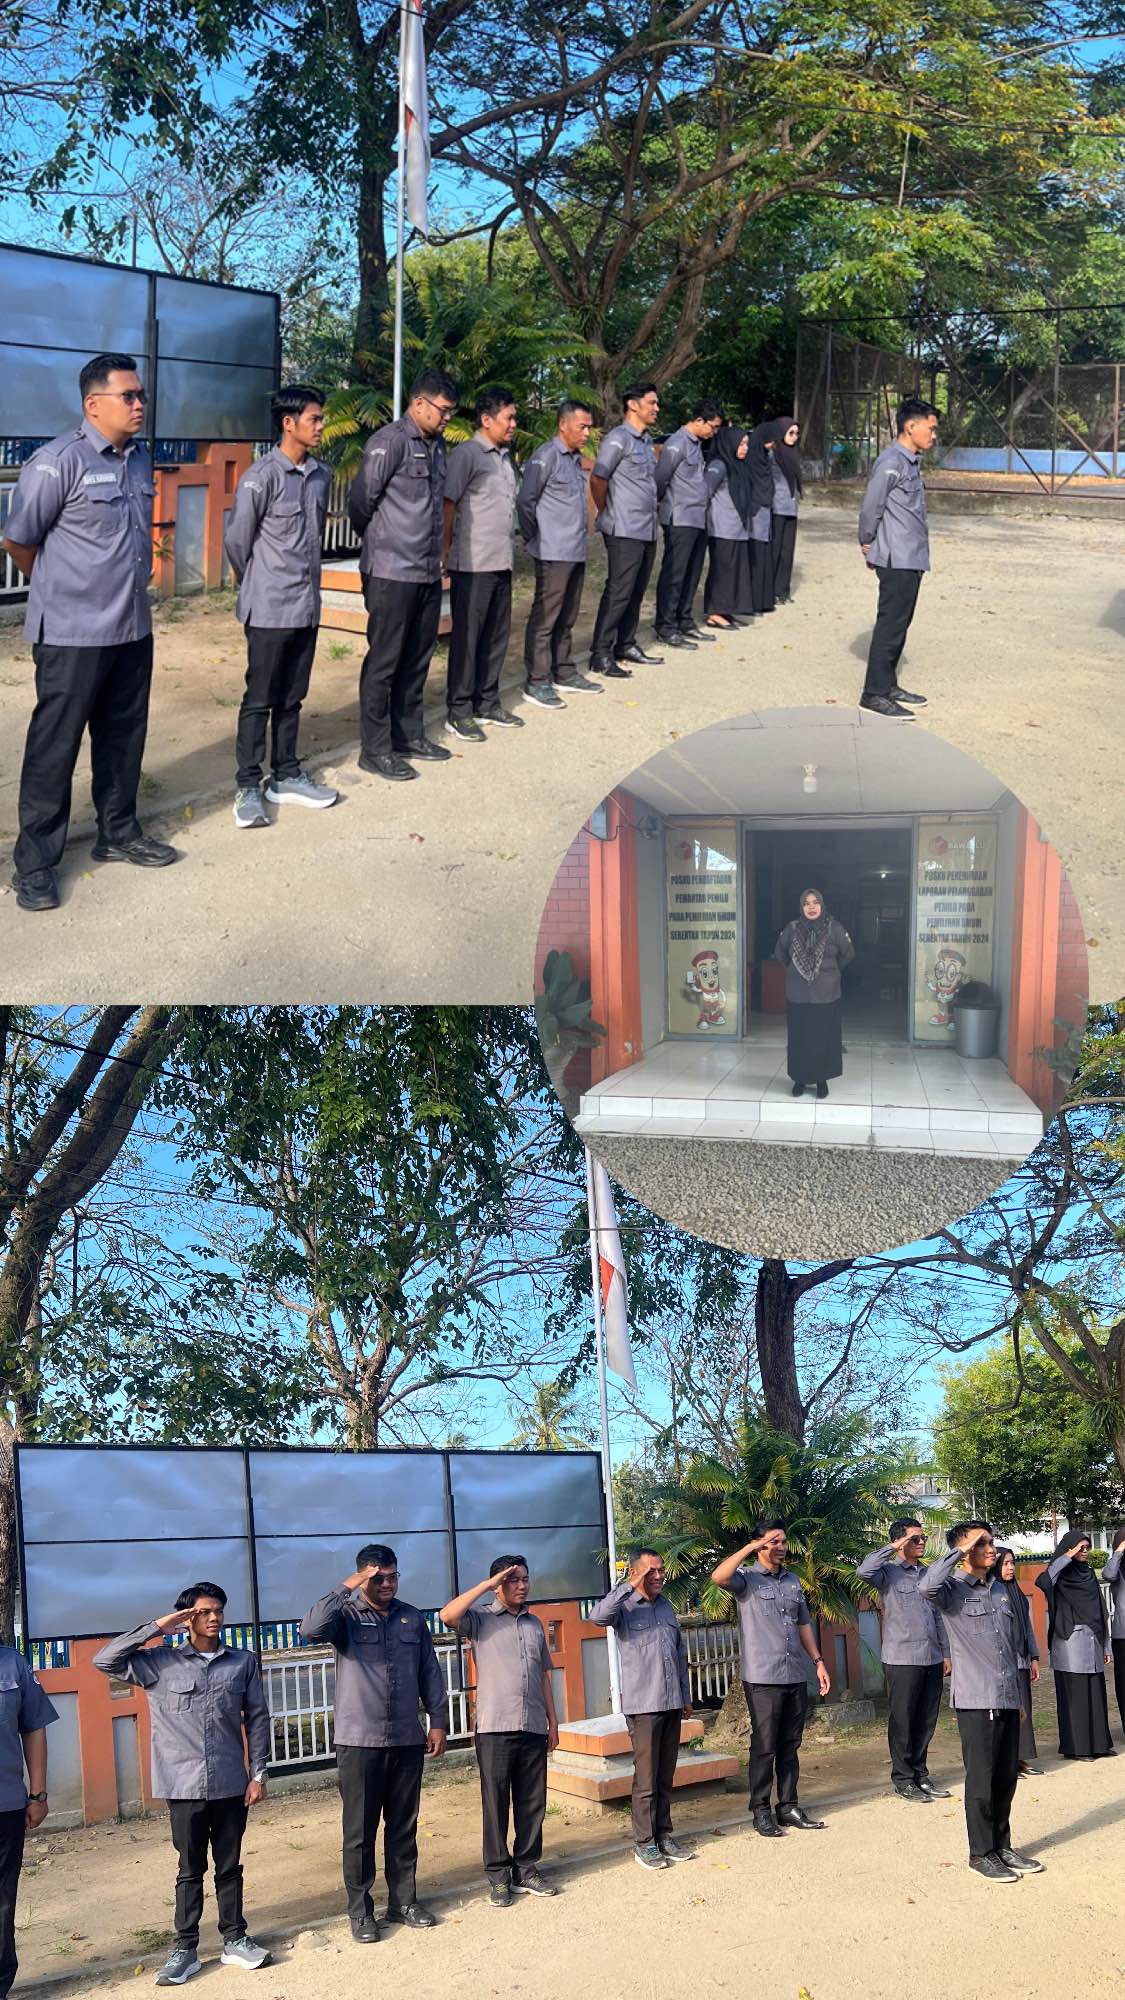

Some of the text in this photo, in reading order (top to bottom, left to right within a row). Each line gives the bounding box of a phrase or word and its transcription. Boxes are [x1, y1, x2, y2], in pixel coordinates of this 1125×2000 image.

[925, 871, 945, 880] POSKO
[919, 887, 946, 896] LAPORAN
[708, 893, 728, 903] PEMILU
[934, 902, 958, 912] PEMILU
[720, 930, 736, 940] 2024
[972, 934, 988, 944] 2024
